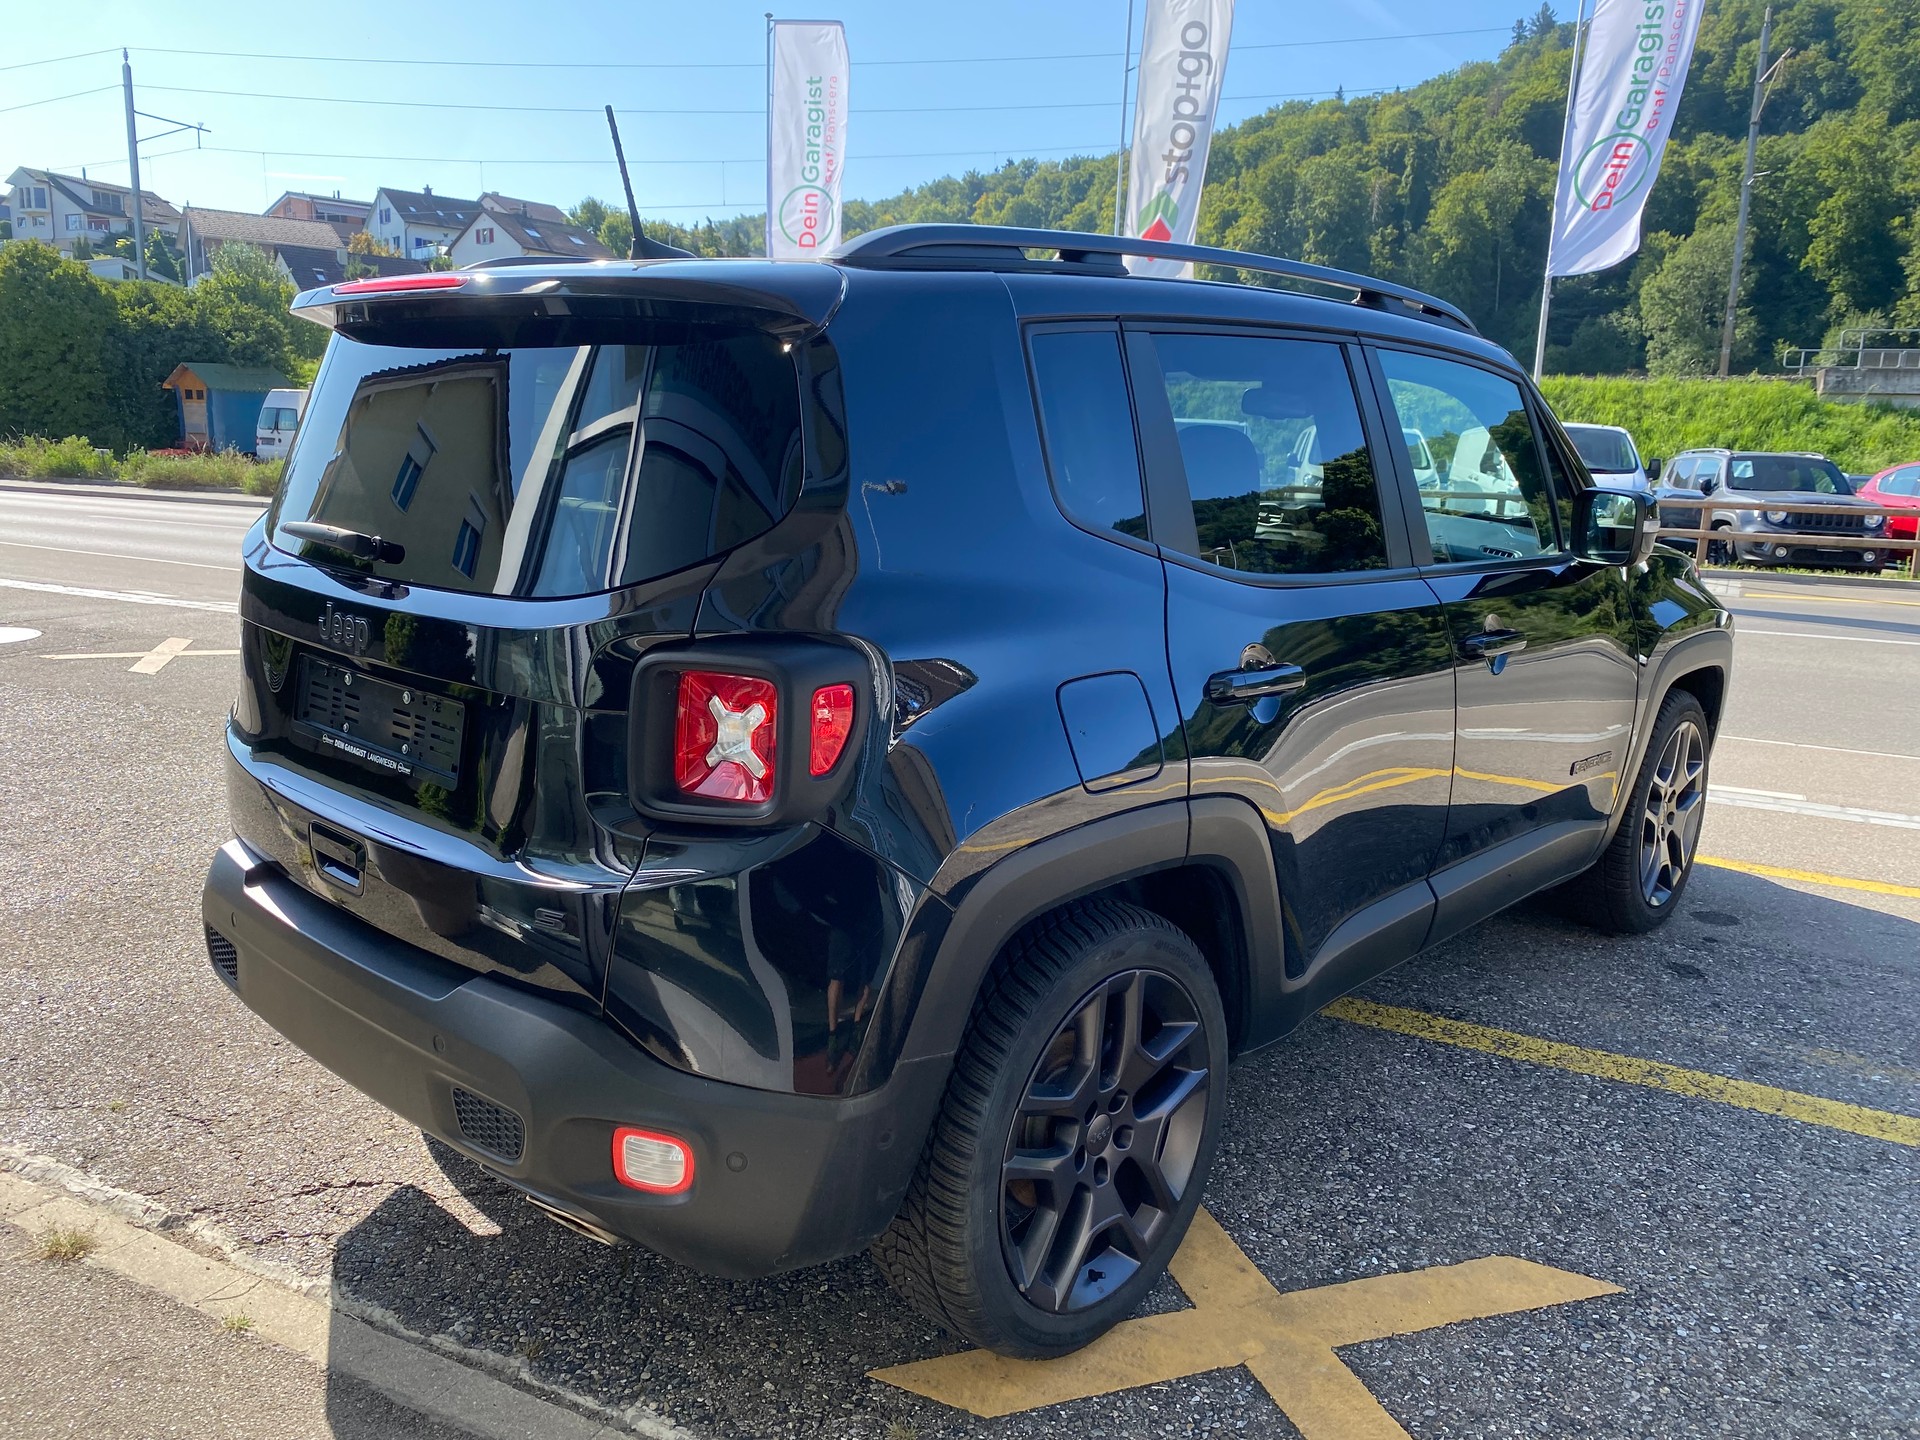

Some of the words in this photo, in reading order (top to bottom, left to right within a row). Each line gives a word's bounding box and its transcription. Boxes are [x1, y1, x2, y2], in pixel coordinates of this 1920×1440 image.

[801, 76, 825, 183] Garagist
[1161, 20, 1213, 184] stop+go
[1591, 142, 1633, 212] Dein
[798, 193, 819, 248] Dein
[318, 601, 371, 656] Jeep
[334, 739, 344, 750] DEIN
[344, 744, 367, 758] GARAGIST
[367, 752, 397, 770] LANGWIESEN
